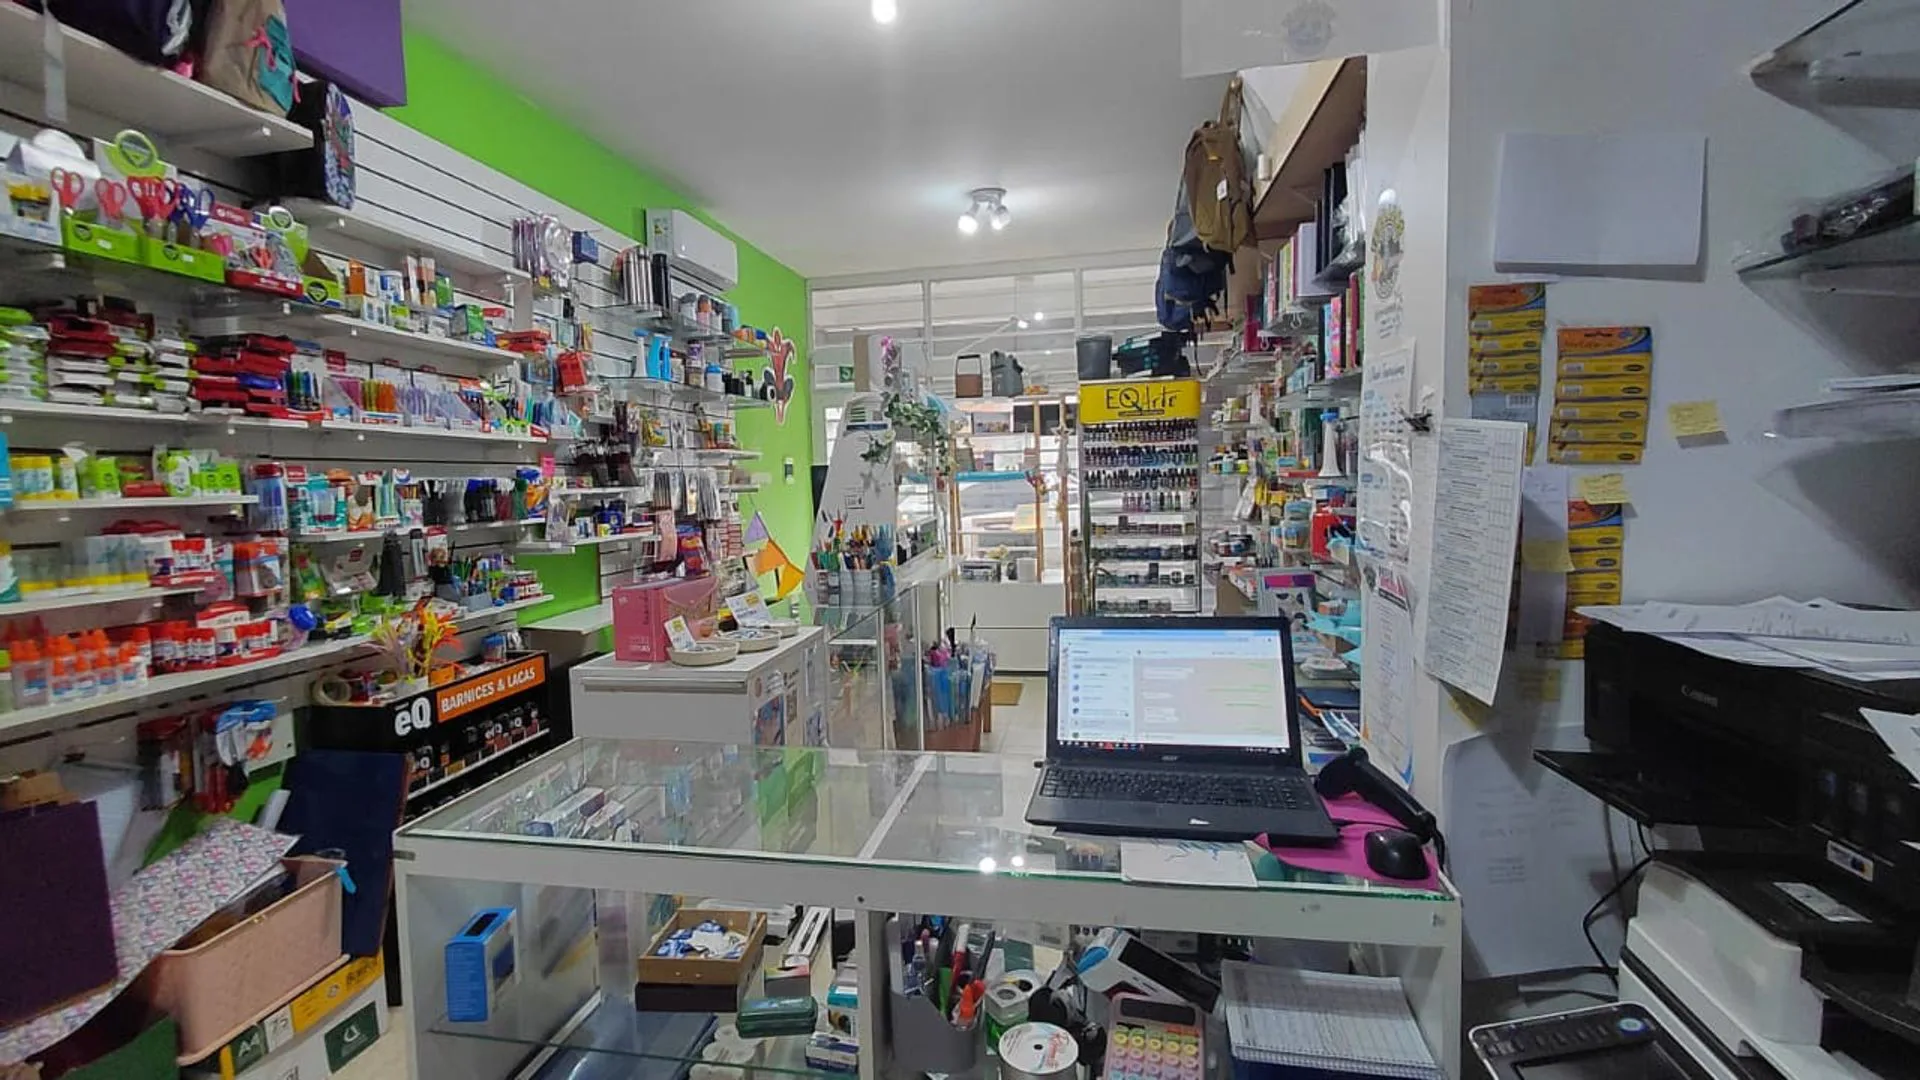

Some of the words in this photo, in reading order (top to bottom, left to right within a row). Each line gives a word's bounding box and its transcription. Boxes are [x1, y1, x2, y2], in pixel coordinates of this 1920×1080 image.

[441, 681, 494, 713] BARNICES
[497, 679, 505, 692] &
[507, 667, 536, 688] LACAS
[394, 697, 432, 736] eQ
[238, 1031, 260, 1058] A4
